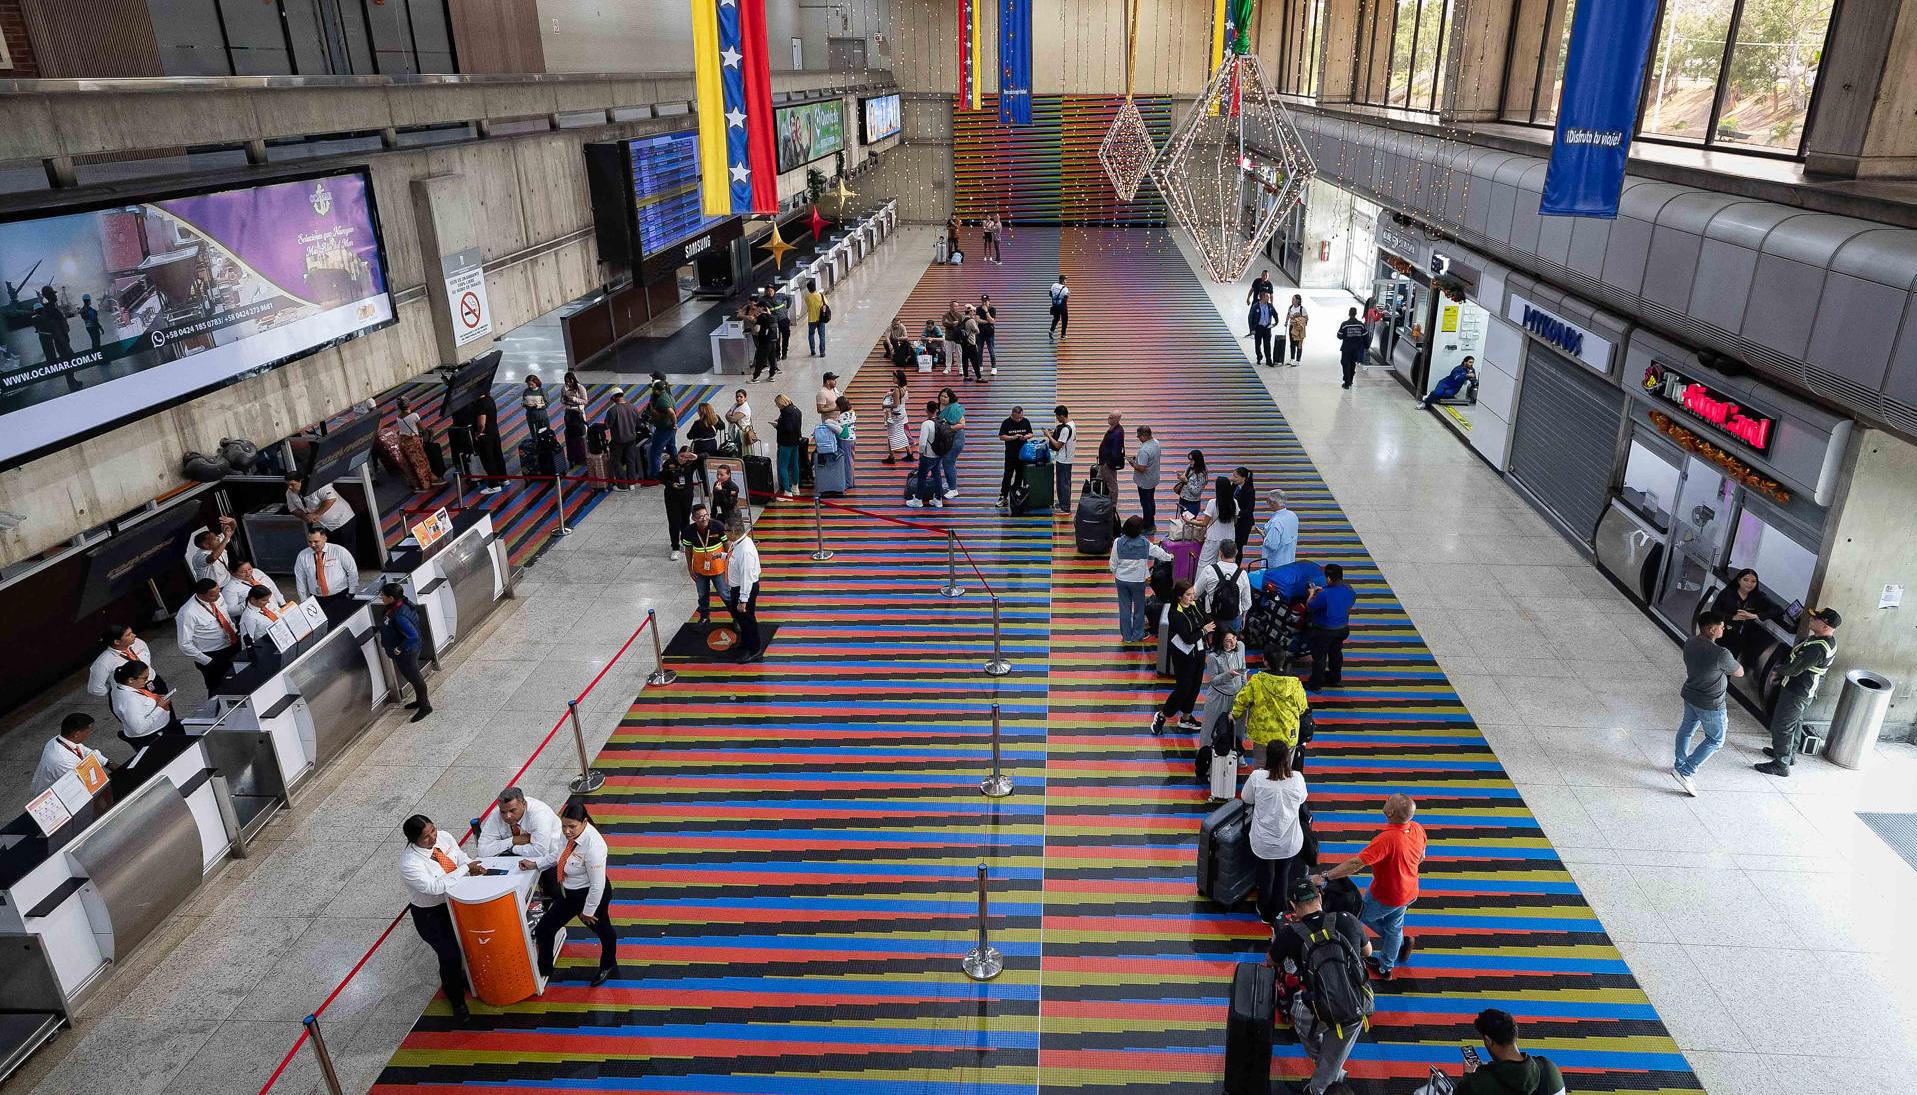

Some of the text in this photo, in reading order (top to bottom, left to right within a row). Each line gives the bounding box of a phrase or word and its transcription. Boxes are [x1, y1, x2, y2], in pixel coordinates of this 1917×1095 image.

[1566, 129, 1622, 147] ¡Disfruta tu viaje!
[684, 234, 711, 259] SAMSUNG
[165, 330, 178, 340] +58
[178, 325, 195, 336] 0424
[195, 321, 207, 331] 185
[224, 313, 236, 322] +58
[235, 309, 250, 319] 0424
[3, 351, 104, 387] WWW.OCAMAR.COM.VE
